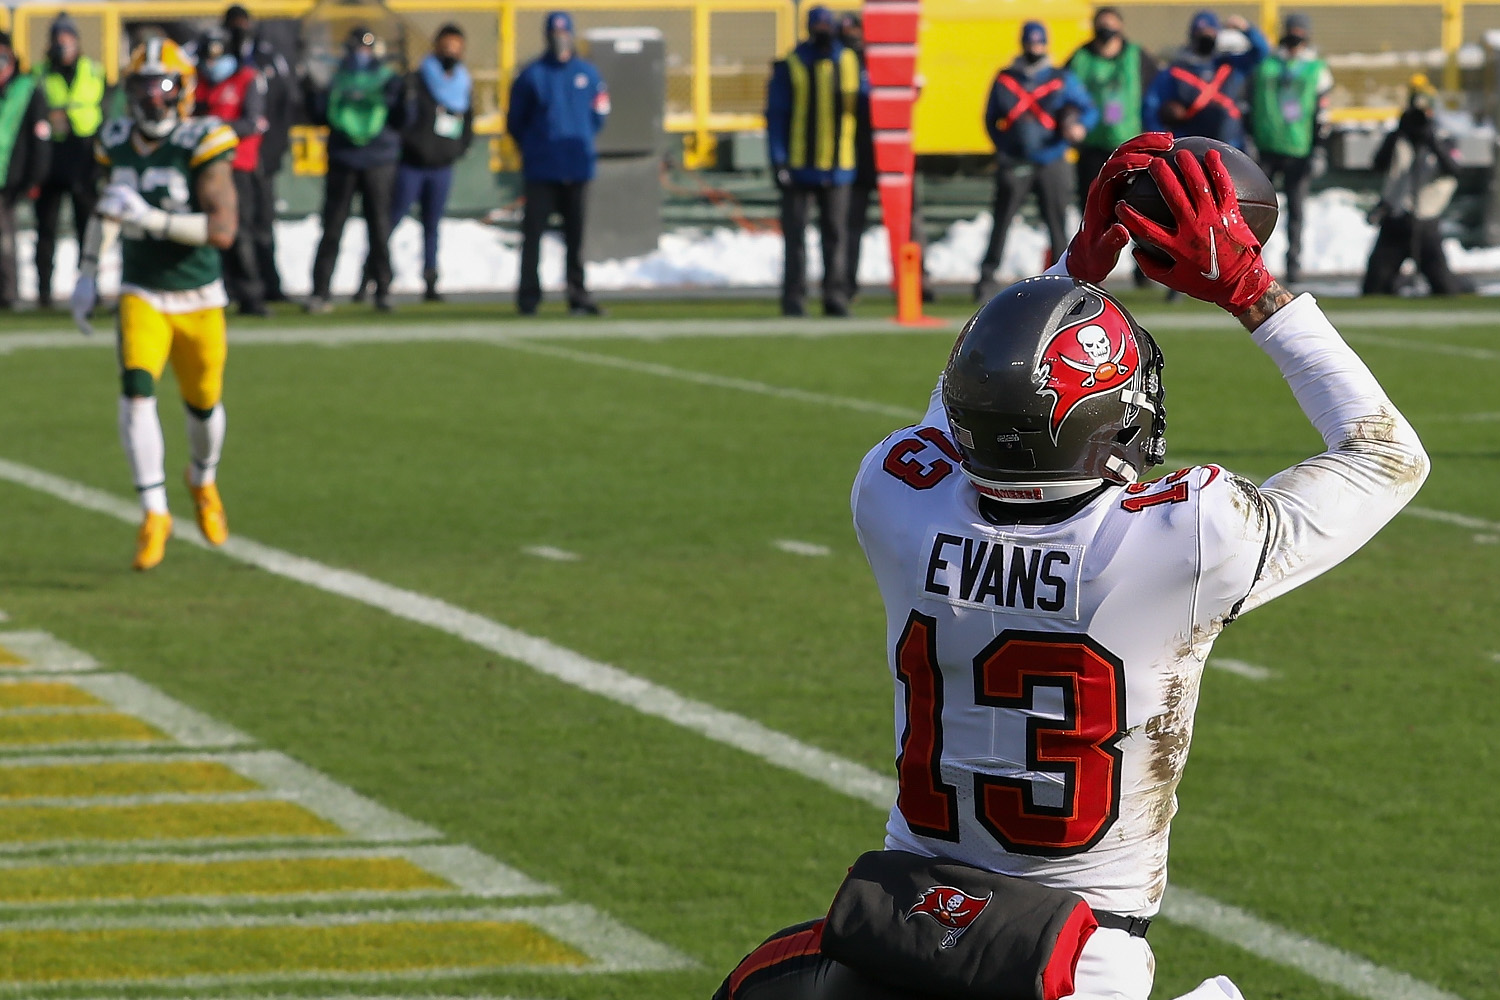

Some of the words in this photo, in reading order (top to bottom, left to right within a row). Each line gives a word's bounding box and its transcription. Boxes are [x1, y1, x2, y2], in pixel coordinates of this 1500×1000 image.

[883, 427, 963, 490] 13
[925, 532, 1070, 612] EVANS
[895, 608, 1126, 856] 13
